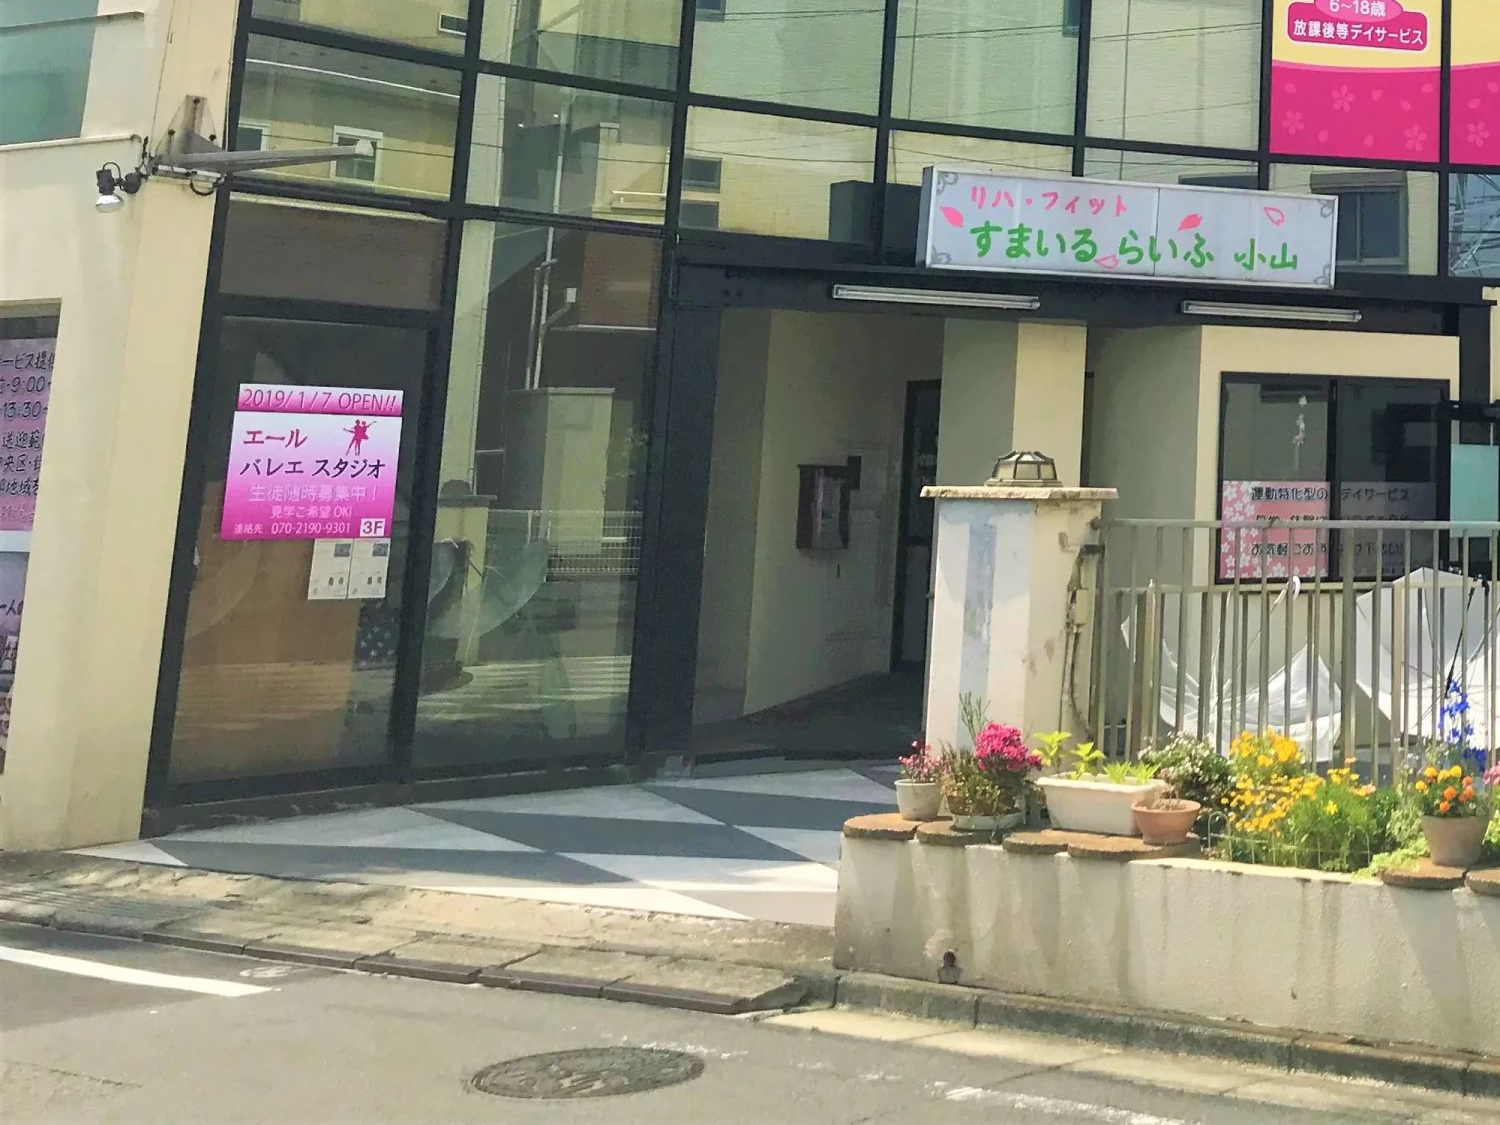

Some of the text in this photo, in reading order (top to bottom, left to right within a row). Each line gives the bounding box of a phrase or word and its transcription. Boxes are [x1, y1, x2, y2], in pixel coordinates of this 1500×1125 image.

[1293, 18, 1424, 45] 放課後等デイサービス
[1234, 238, 1298, 271] 小山
[338, 393, 397, 412] OPEN!!
[243, 429, 308, 448] エール
[240, 459, 386, 479] バレエ スタジオ
[271, 522, 351, 535] 070-2190-9301
[362, 520, 385, 535] 3F
